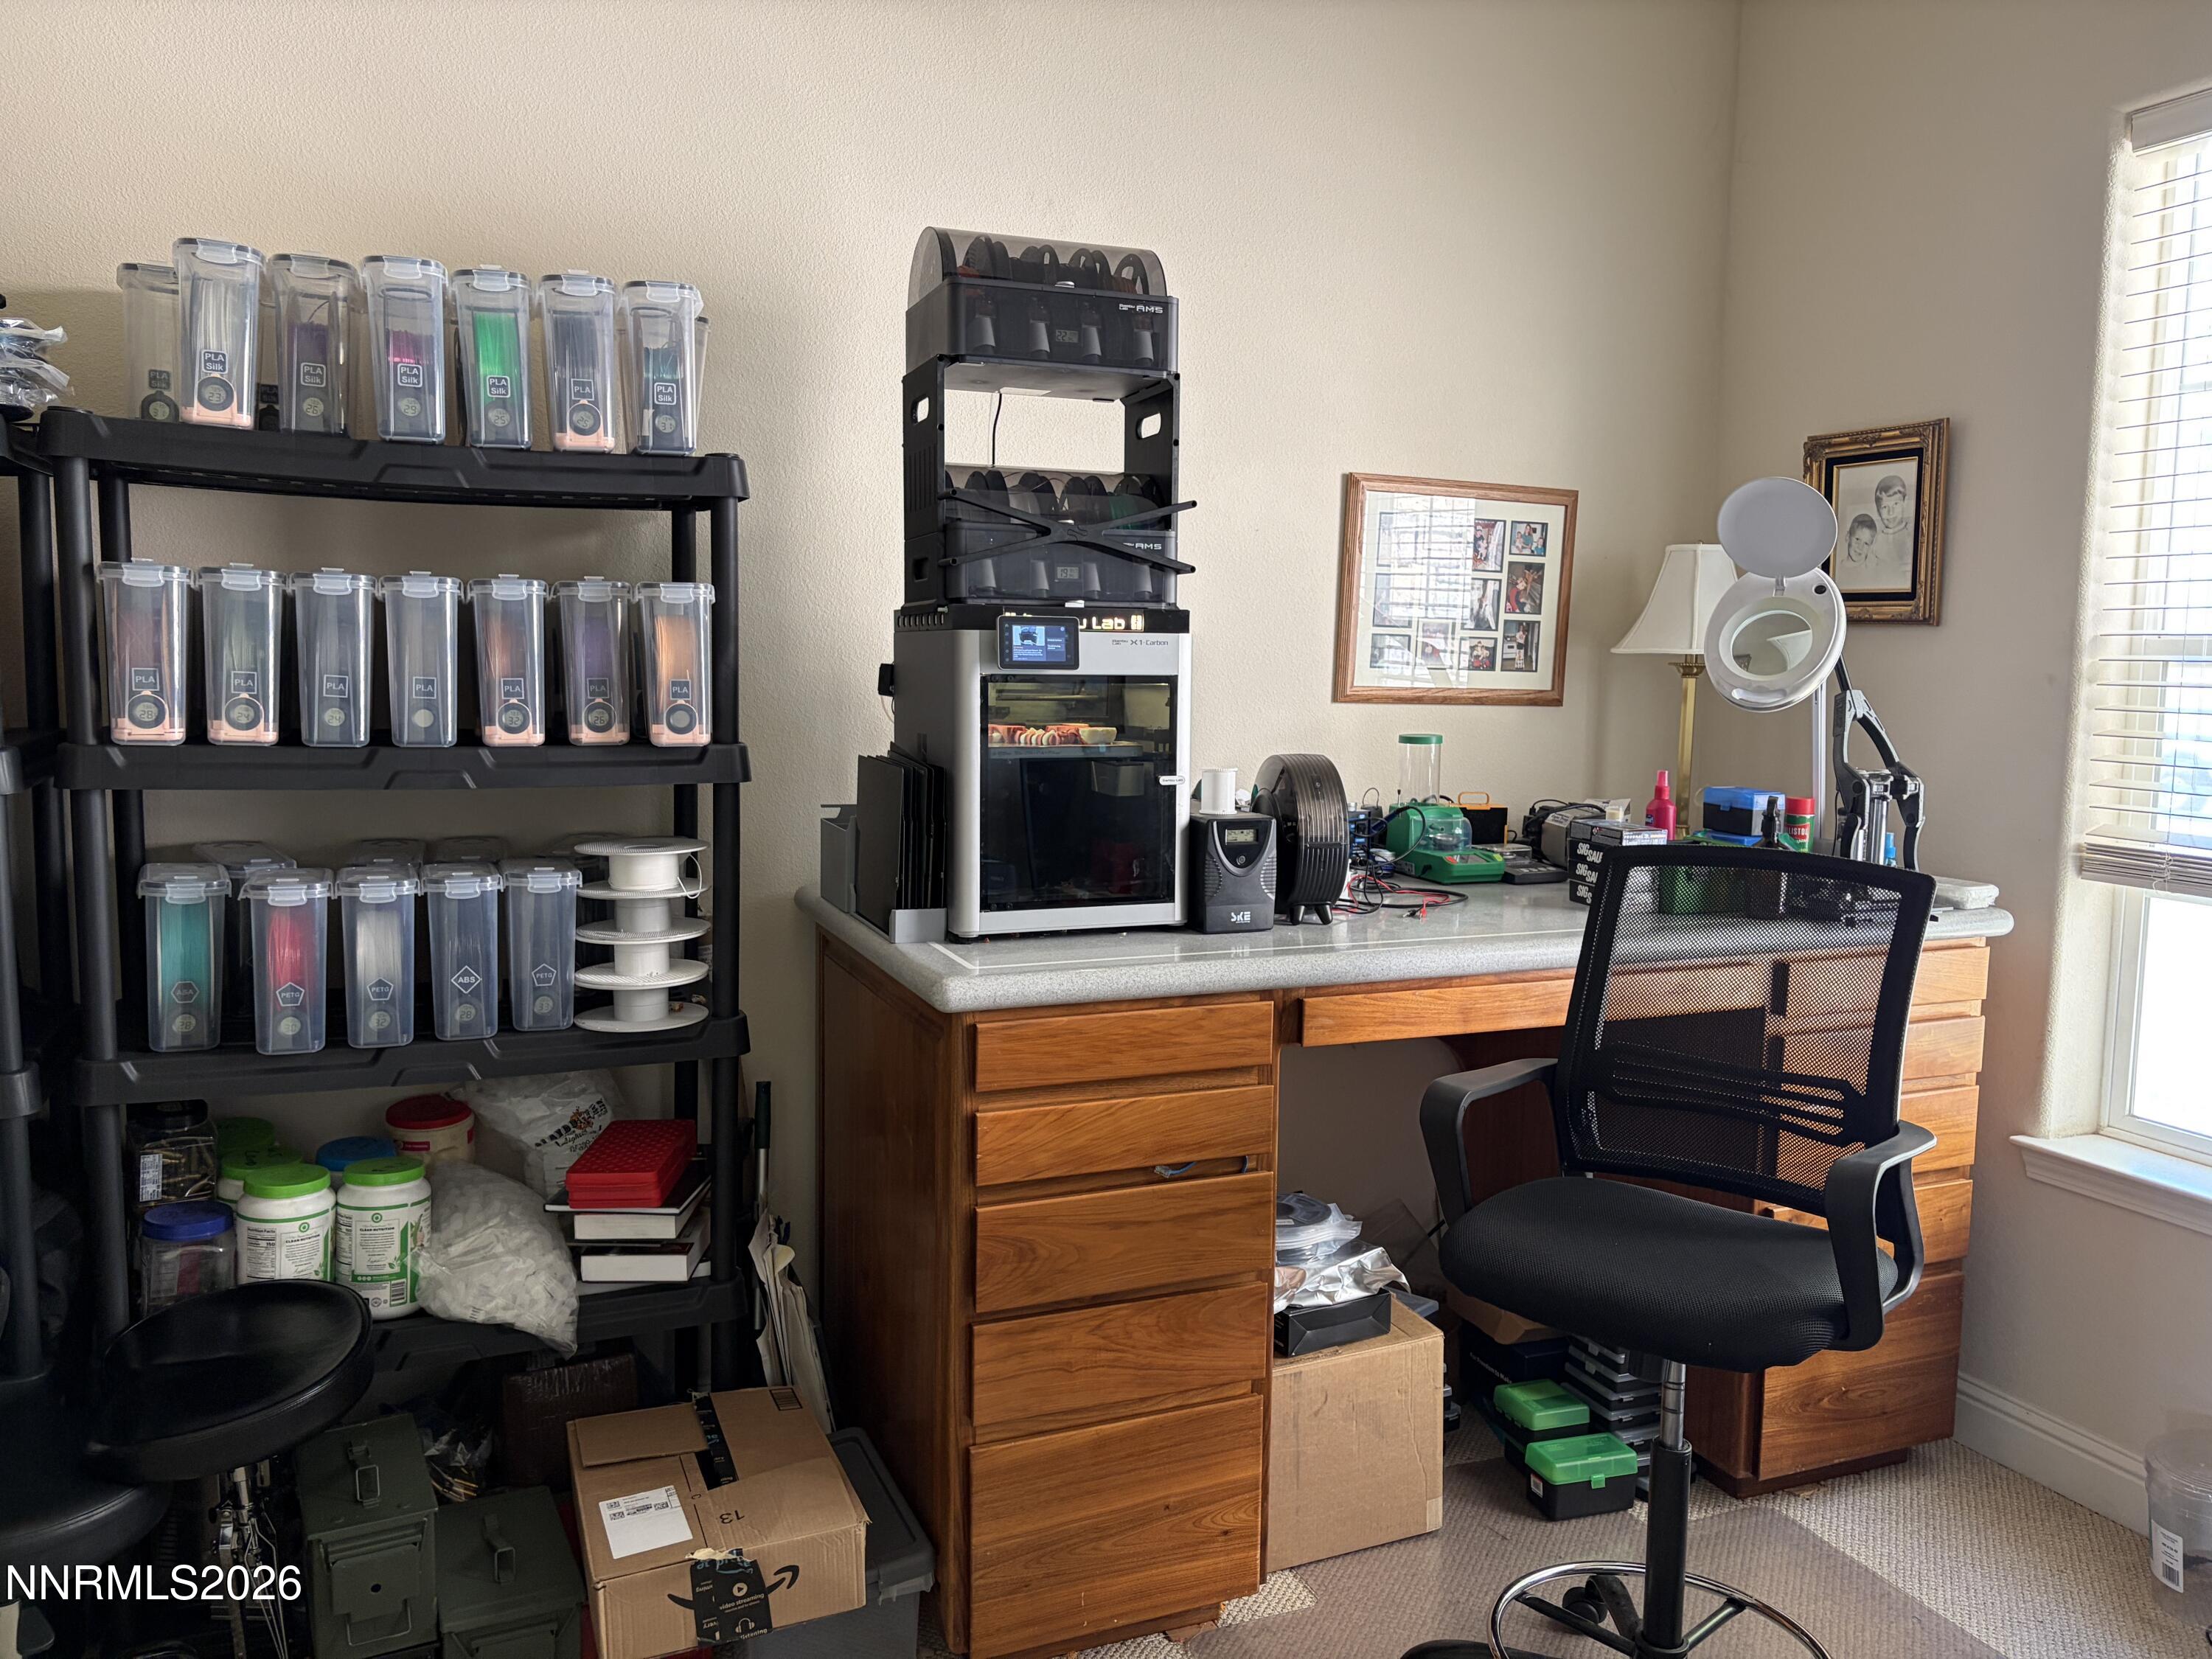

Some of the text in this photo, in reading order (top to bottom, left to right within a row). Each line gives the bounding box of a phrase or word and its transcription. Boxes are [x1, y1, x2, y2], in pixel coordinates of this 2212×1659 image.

[1136, 305, 1164, 313] AMS
[205, 353, 224, 361] PLA
[206, 363, 223, 371] Silk
[304, 366, 322, 375] PLA
[400, 366, 419, 375] PLA
[150, 371, 168, 379] PLA
[305, 375, 321, 384] Silk
[401, 376, 418, 384] Silk
[209, 392, 221, 401] 23
[493, 415, 506, 425] 25
[1092, 616, 1125, 630] Lab
[236, 712, 249, 721] 24
[594, 716, 605, 724] 26
[509, 717, 520, 726] 32
[1577, 843, 1590, 856] SIG
[1576, 863, 1588, 877] SIG
[1576, 885, 1589, 898] SIG
[1231, 911, 1251, 922] SKE
[460, 1010, 472, 1019] 28
[720, 1601, 735, 1610] video
[736, 1593, 765, 1605] streaming
